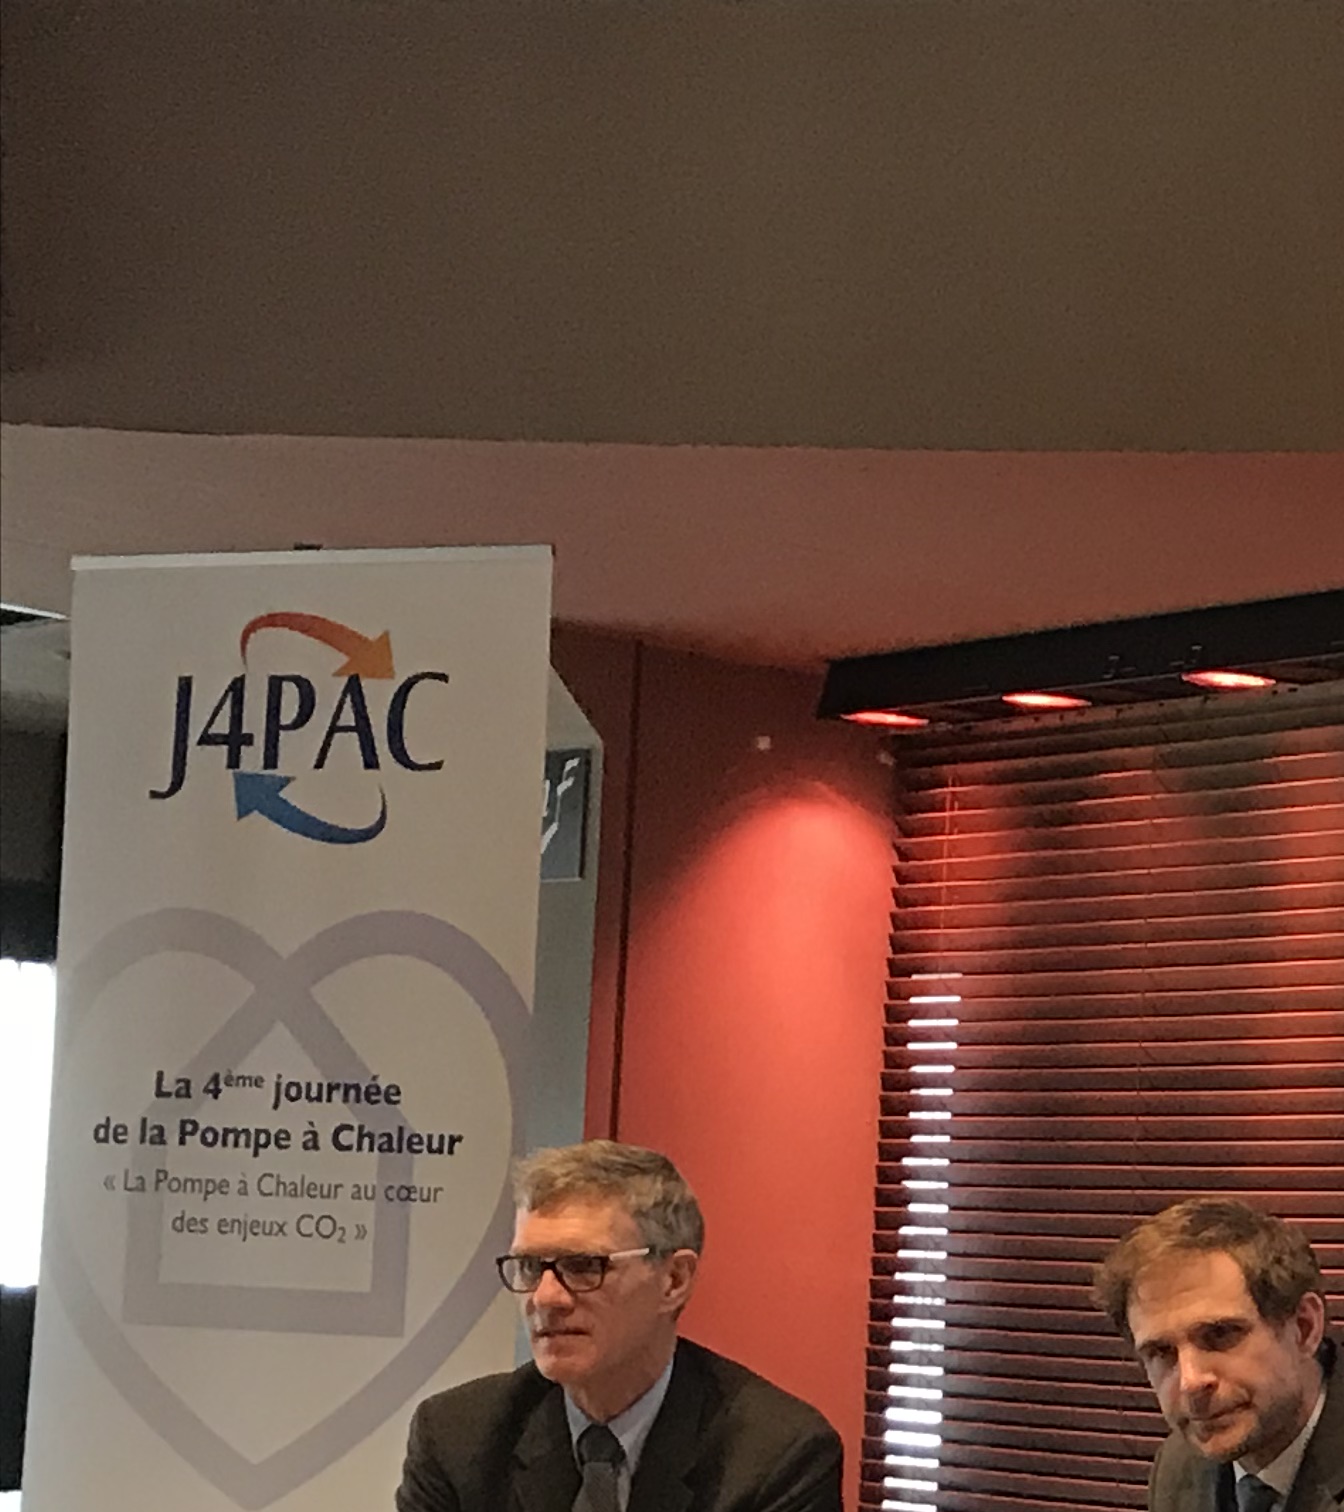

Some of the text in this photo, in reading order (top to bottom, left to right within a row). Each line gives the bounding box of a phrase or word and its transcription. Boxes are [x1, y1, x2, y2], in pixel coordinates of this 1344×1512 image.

[149, 671, 449, 799] J4PAC
[155, 1070, 401, 1109] La 4ème journée
[93, 1117, 463, 1157] de la Pompe à Chaleur
[122, 1171, 146, 1194] La
[154, 1171, 230, 1200] Pompe
[238, 1173, 249, 1197] à
[256, 1173, 343, 1202] Chaleur
[350, 1182, 376, 1202] au
[171, 1211, 207, 1235] des
[215, 1215, 287, 1242] enjeux
